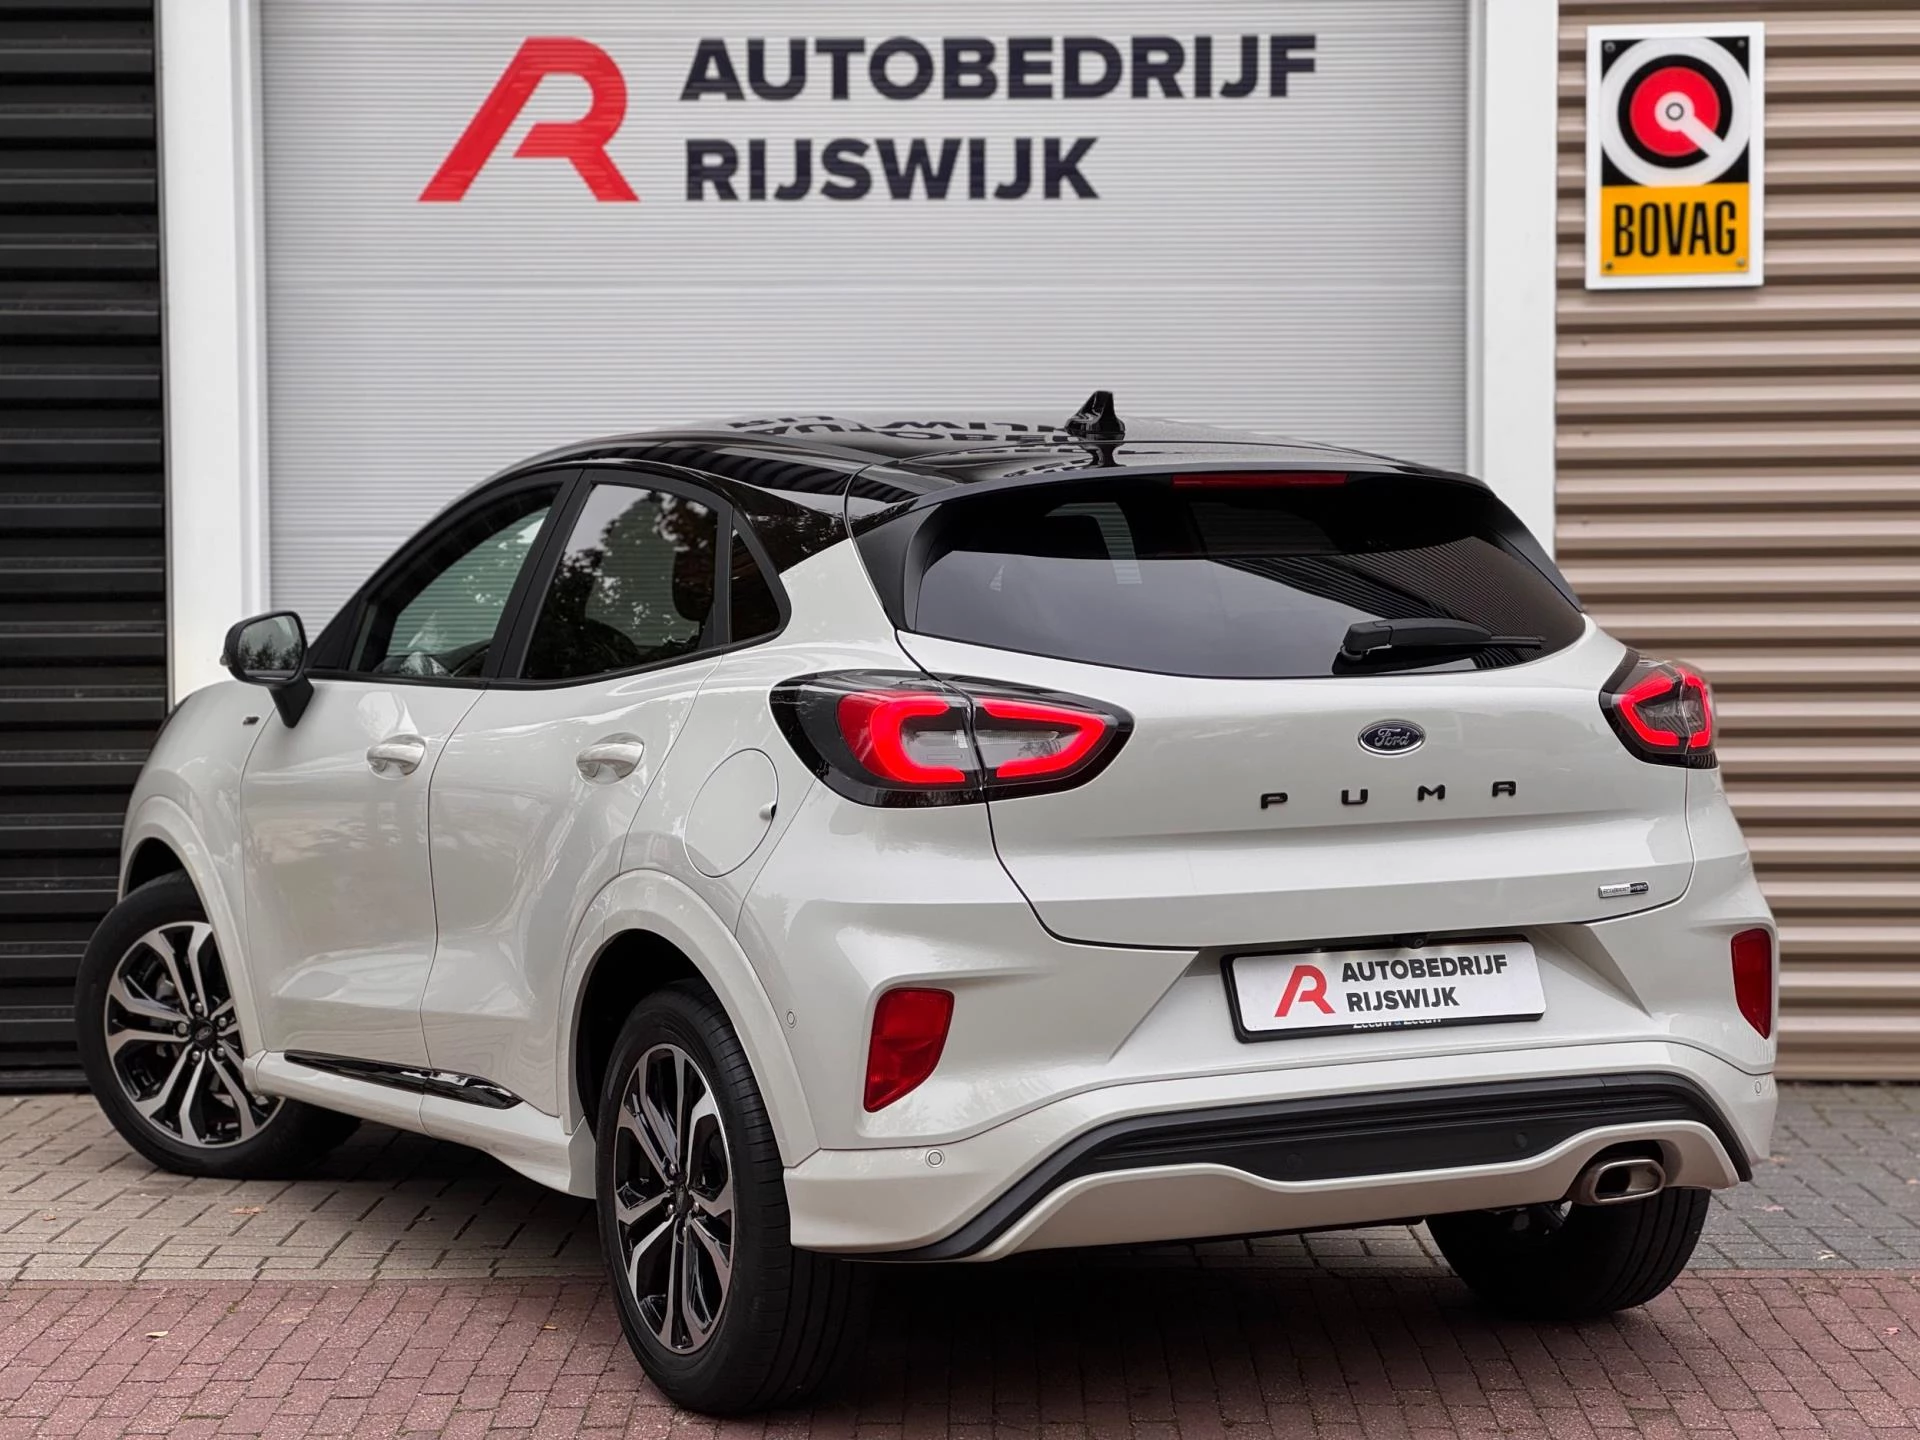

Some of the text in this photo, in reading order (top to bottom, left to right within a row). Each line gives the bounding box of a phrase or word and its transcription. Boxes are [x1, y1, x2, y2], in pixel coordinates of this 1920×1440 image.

[681, 35, 1316, 101] AUTOBEDRIJF
[686, 138, 1100, 201] RIJSWIJK
[1614, 200, 1737, 257] BOVAG
[1374, 728, 1411, 747] Ford
[1260, 780, 1517, 810] PUMA
[1342, 953, 1508, 983] AUTOBEDRIJF
[1346, 986, 1460, 1013] RIJSWIJK
